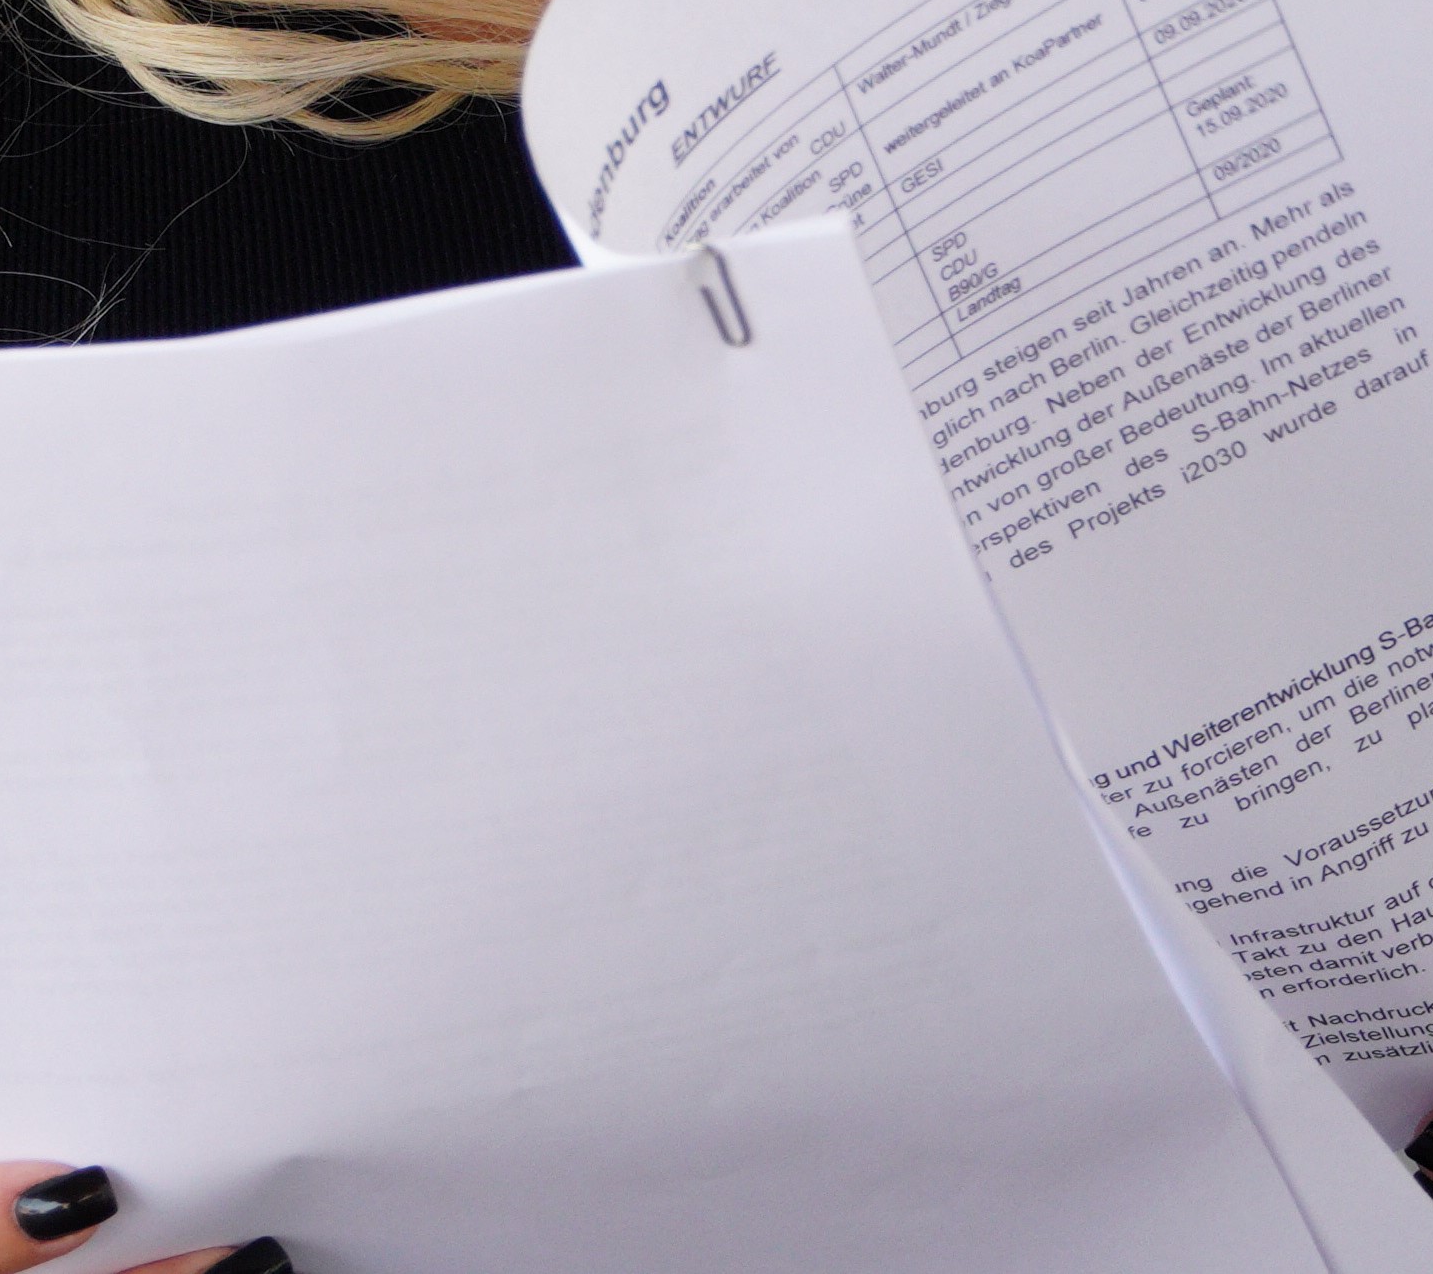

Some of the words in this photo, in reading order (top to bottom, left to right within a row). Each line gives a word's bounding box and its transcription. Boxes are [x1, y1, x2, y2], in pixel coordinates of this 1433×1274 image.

[857, 18, 964, 94] Walter-Mundt
[964, 10, 972, 28] /
[884, 81, 987, 155] weitergeleitet
[989, 68, 1010, 88] an
[1011, 13, 1103, 72] KoaPartner
[670, 51, 780, 167] ENTWURF
[809, 122, 847, 156] CDU
[1195, 82, 1288, 138] 15.09.2020
[710, 156, 773, 221] erarbeitet
[773, 134, 800, 161] von
[828, 160, 863, 194] SPD
[901, 158, 944, 193] GESI
[1213, 137, 1281, 182] 09/2020
[760, 170, 822, 223] Koalition
[932, 232, 967, 262] SPD
[940, 248, 978, 281] CDU
[948, 262, 998, 302] B90/G
[983, 327, 1067, 382] steigen
[1072, 299, 1117, 332] seit
[1123, 256, 1203, 309] Jahren
[1208, 238, 1246, 263] an.
[1249, 201, 1313, 241] Mehr
[1320, 181, 1355, 207] als
[933, 405, 985, 449] glich
[989, 369, 1047, 412] nach
[1048, 329, 1126, 377] Berlin.
[1129, 258, 1268, 335] Gleichzeitig
[1271, 209, 1368, 270] pendeln
[956, 277, 1022, 322] Landtag
[1046, 364, 1126, 414] Neben
[1134, 338, 1174, 369] der
[1182, 264, 1327, 345] Entwicklung
[1335, 237, 1381, 269] des
[950, 427, 1072, 501] ntwicklung
[1077, 402, 1115, 432] der
[1123, 338, 1250, 411] Außenäste
[1255, 314, 1294, 343] der
[1297, 265, 1392, 321] Berliner
[962, 508, 982, 526] n
[986, 483, 1031, 512] von
[1036, 438, 1113, 491] großer
[1119, 372, 1256, 445] Bedeutung.
[1260, 351, 1294, 375] Im
[1299, 295, 1406, 359] aktuellen
[1124, 446, 1169, 477] des
[1190, 347, 1372, 444] S-Bahn-Netzes
[1393, 324, 1418, 345] in
[1009, 537, 1053, 569] des
[1067, 482, 1166, 539] Projekts
[1180, 439, 1247, 484] i2030
[1263, 399, 1337, 443] wurde
[1353, 348, 1432, 400] darauf
[1115, 750, 1161, 780] und
[1162, 645, 1375, 759] Weiterentwicklung
[1144, 775, 1174, 794] zu
[1181, 721, 1292, 781] forcieren,
[1298, 695, 1337, 722] um
[1343, 672, 1379, 699] die
[1134, 754, 1279, 818] Außenästen
[1295, 723, 1333, 753] der
[1180, 812, 1209, 829] zu
[1234, 758, 1331, 812] bringen,
[1354, 729, 1383, 753] zu
[1231, 865, 1268, 883] die
[1290, 874, 1313, 892] in
[1321, 833, 1395, 883] Angriff
[1401, 821, 1429, 845] zu
[1230, 904, 1375, 946] Infrastruktur
[1385, 880, 1421, 911] auf
[1232, 946, 1289, 964] Takt
[1297, 943, 1326, 955] zu
[1337, 928, 1382, 949] den
[1282, 962, 1426, 995] erforderlich.
[1309, 950, 1378, 971] damit
